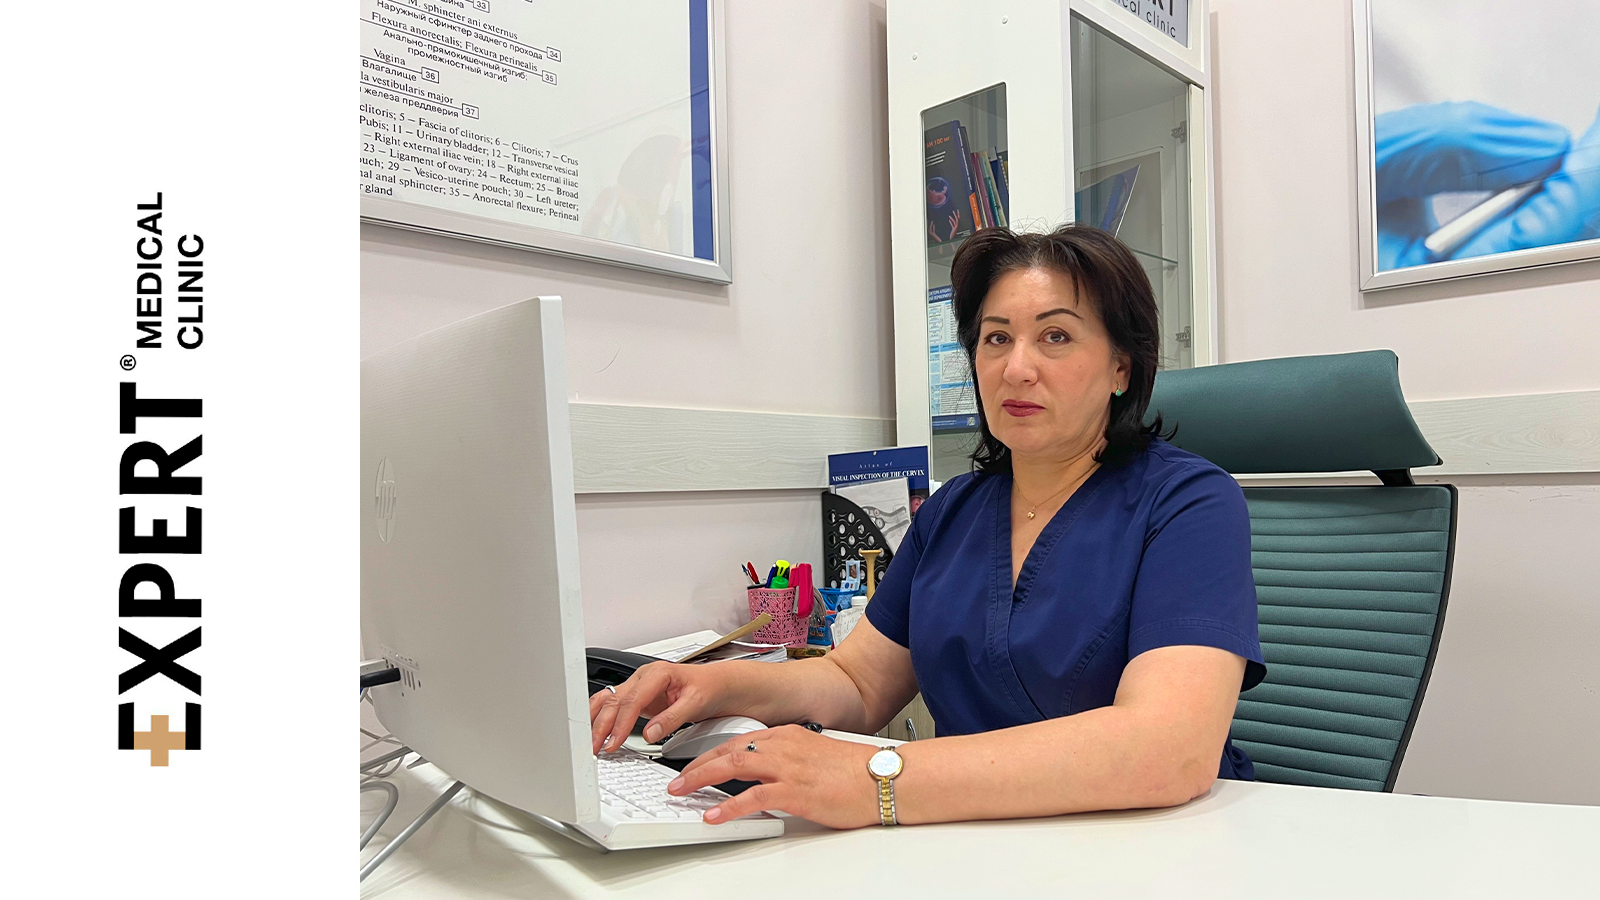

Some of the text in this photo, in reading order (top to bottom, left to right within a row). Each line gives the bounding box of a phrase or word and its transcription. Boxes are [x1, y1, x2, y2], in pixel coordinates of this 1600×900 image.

[477, 1, 486, 9] 33
[377, 0, 543, 60] Наружный сфинктер заднего прохода
[424, 2, 466, 21] sphincter
[468, 17, 481, 27] ani
[483, 22, 518, 40] externus
[1146, 11, 1176, 37] clinic
[372, 12, 538, 72] Flexura anorectalis; Flexura perinealis
[374, 48, 406, 65] Vagina
[383, 29, 528, 81] Анально-прямокишечный изгиб;
[550, 50, 558, 59] 34
[362, 59, 417, 81] Влагалище
[408, 47, 508, 82] промежностный изгиб
[425, 71, 435, 80] 36
[545, 74, 554, 82] 35
[364, 87, 400, 102] железа
[403, 98, 459, 118] преддверия
[372, 76, 425, 96] vestibularis
[428, 91, 453, 104] major
[466, 107, 475, 115] 37
[360, 104, 396, 121] clitoris;
[400, 113, 404, 121] 5
[419, 118, 446, 132] Fascia
[450, 126, 459, 135] of
[461, 128, 492, 145] clitoris;
[495, 138, 500, 146] 6
[512, 142, 544, 158] Clitoris;
[561, 154, 578, 166] Crus
[360, 115, 388, 132] Pubis;
[393, 124, 402, 134] 11
[417, 130, 452, 147] Urinary
[454, 139, 489, 156] bladder;
[492, 149, 501, 158] 12
[512, 153, 553, 171] Transverse
[555, 165, 578, 177] vesical
[363, 143, 375, 153] 23
[390, 149, 434, 167] Ligament
[437, 161, 447, 170] of
[449, 164, 474, 177] ovary;
[478, 170, 487, 178] 24
[500, 174, 534, 190] Rectum;
[536, 182, 546, 191] 25
[557, 187, 578, 199] Broad
[375, 132, 400, 146] Right
[403, 141, 440, 156] external
[443, 149, 461, 160] iliac
[464, 154, 484, 166] vein;
[487, 159, 496, 168] 18
[507, 164, 528, 177] Right
[531, 172, 561, 184] external
[563, 177, 578, 188] iliac
[365, 184, 393, 196] gland
[376, 173, 396, 184] anal
[399, 178, 446, 195] sphincter;
[449, 187, 460, 197] 35
[473, 193, 513, 208] Anorectal
[517, 202, 546, 216] flexure;
[549, 209, 579, 221] Perineal
[388, 161, 400, 171] 29
[415, 166, 479, 188] Vesico-uterine
[482, 184, 511, 196] pouch;
[514, 189, 524, 198] 30
[536, 194, 551, 204] Left
[554, 200, 579, 211] ureter;
[850, 472, 880, 480] INSPECTION
[902, 469, 924, 478] CERVIX
